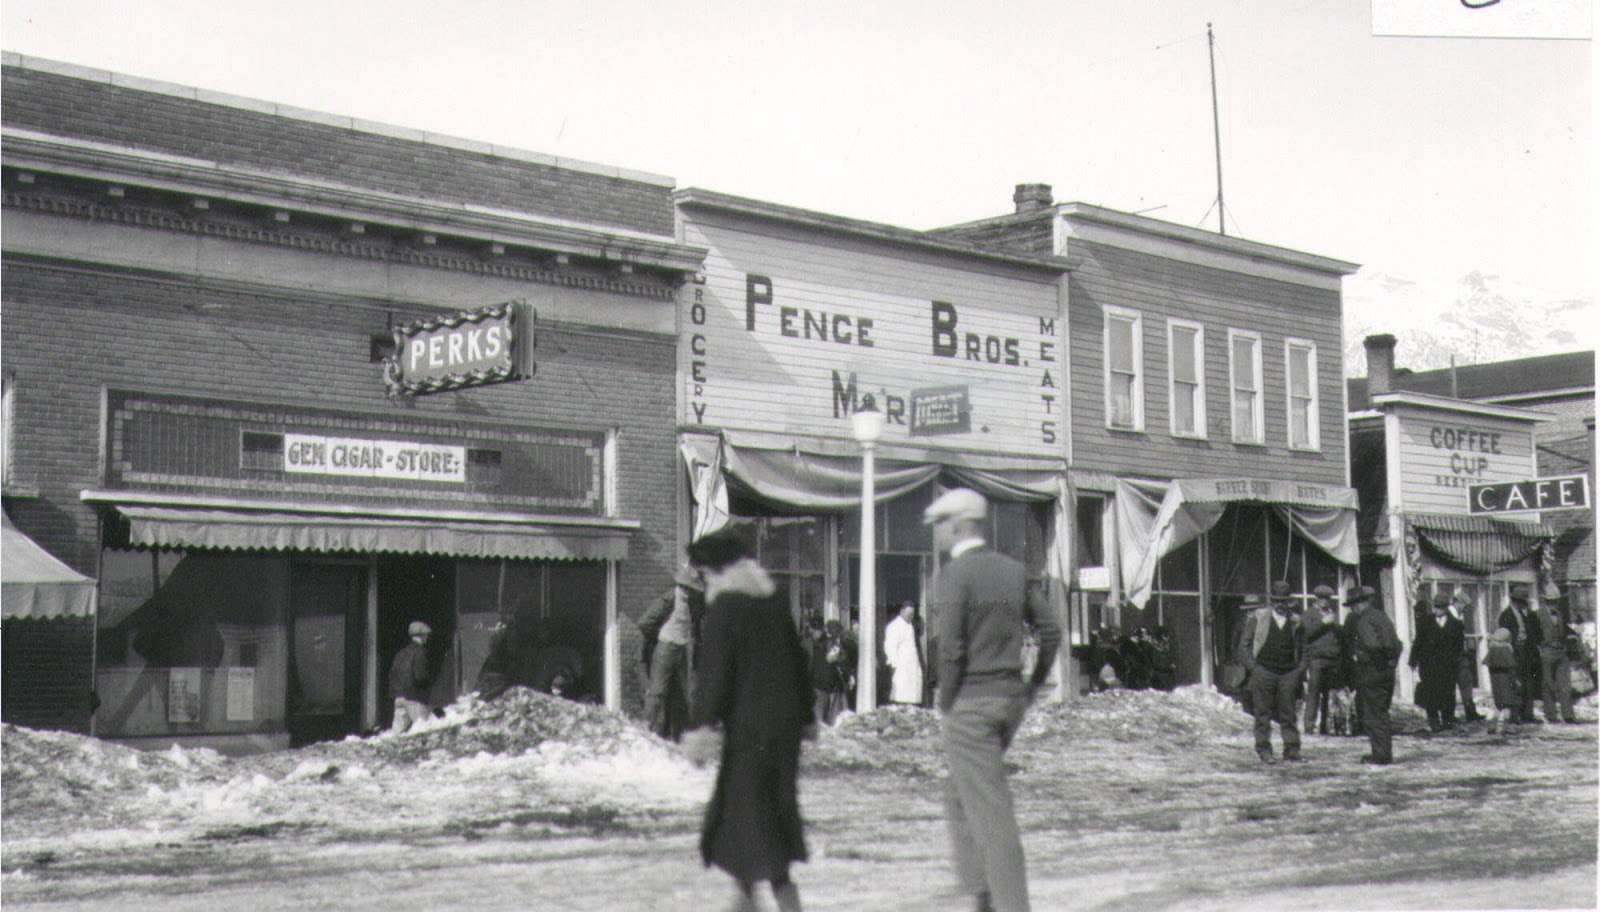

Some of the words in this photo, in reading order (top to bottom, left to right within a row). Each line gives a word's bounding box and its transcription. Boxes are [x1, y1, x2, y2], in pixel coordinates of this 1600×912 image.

[745, 273, 874, 347] PENCE
[932, 300, 1029, 367] BROS.
[410, 326, 502, 372] PERKS
[691, 263, 707, 424] GROCERY
[1039, 316, 1057, 444] MEATS
[288, 442, 326, 466] GEM
[1430, 426, 1502, 454] COFFEE
[1450, 452, 1489, 477] CUP
[1477, 480, 1576, 511] CAFE
